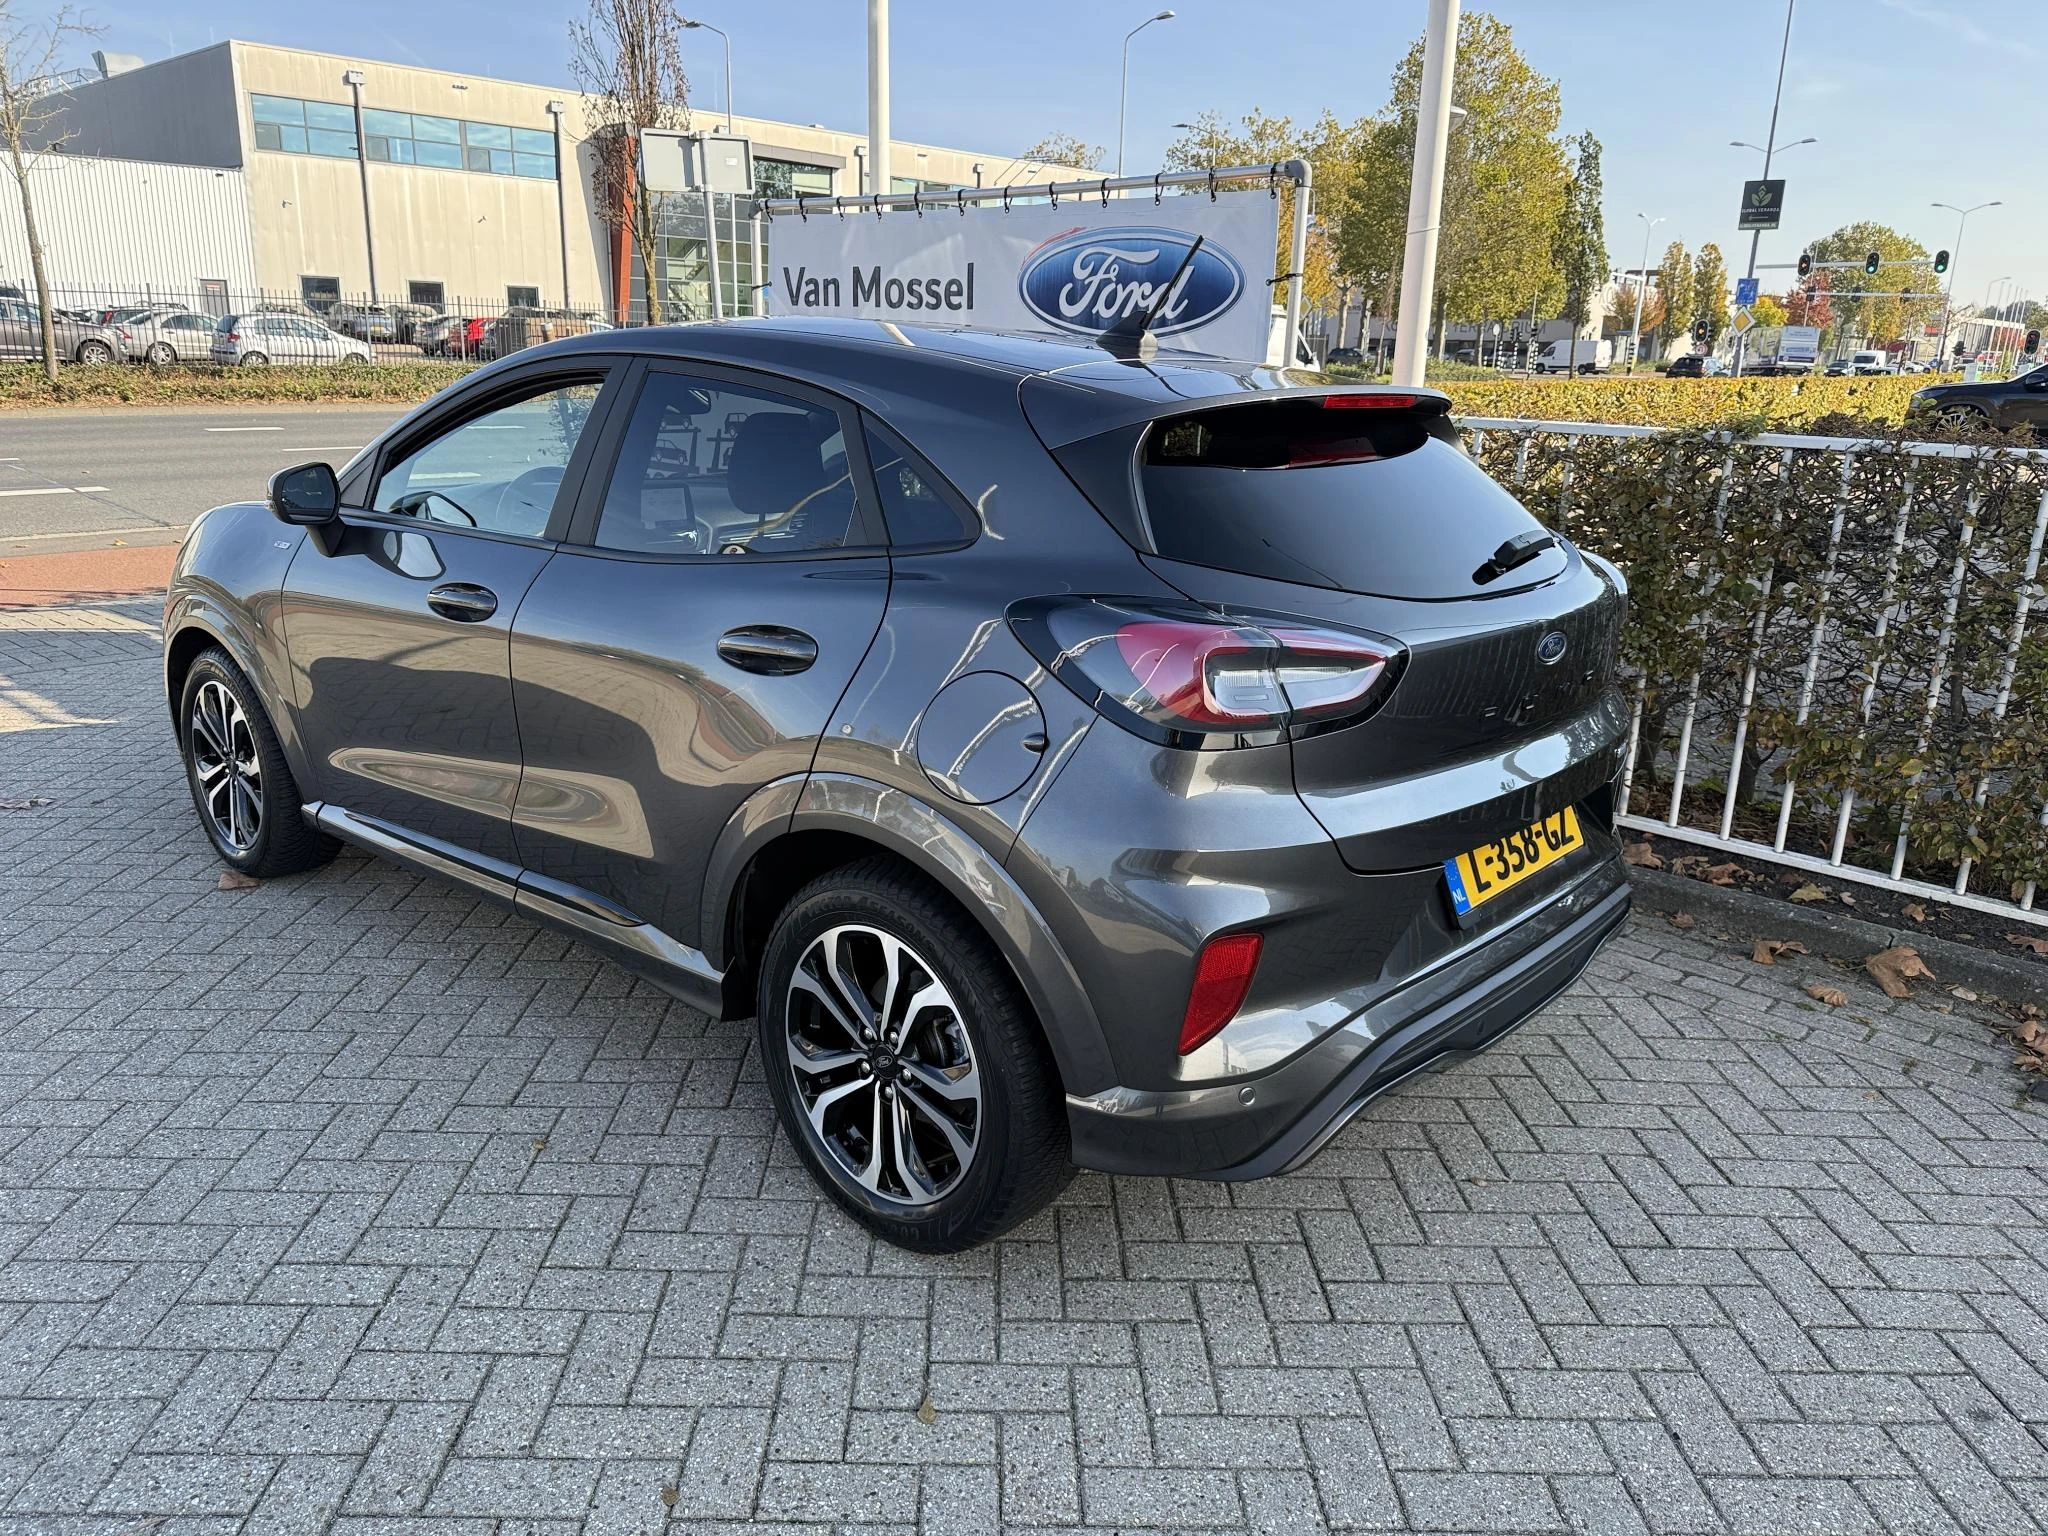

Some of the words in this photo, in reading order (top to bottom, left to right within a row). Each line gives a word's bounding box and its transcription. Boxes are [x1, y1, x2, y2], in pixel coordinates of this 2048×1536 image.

[783, 266, 840, 307] Van
[852, 262, 975, 310] Mossel
[1059, 247, 1194, 320] Ford
[1467, 810, 1575, 894] L-358-GZ
[1452, 887, 1467, 905] NL
